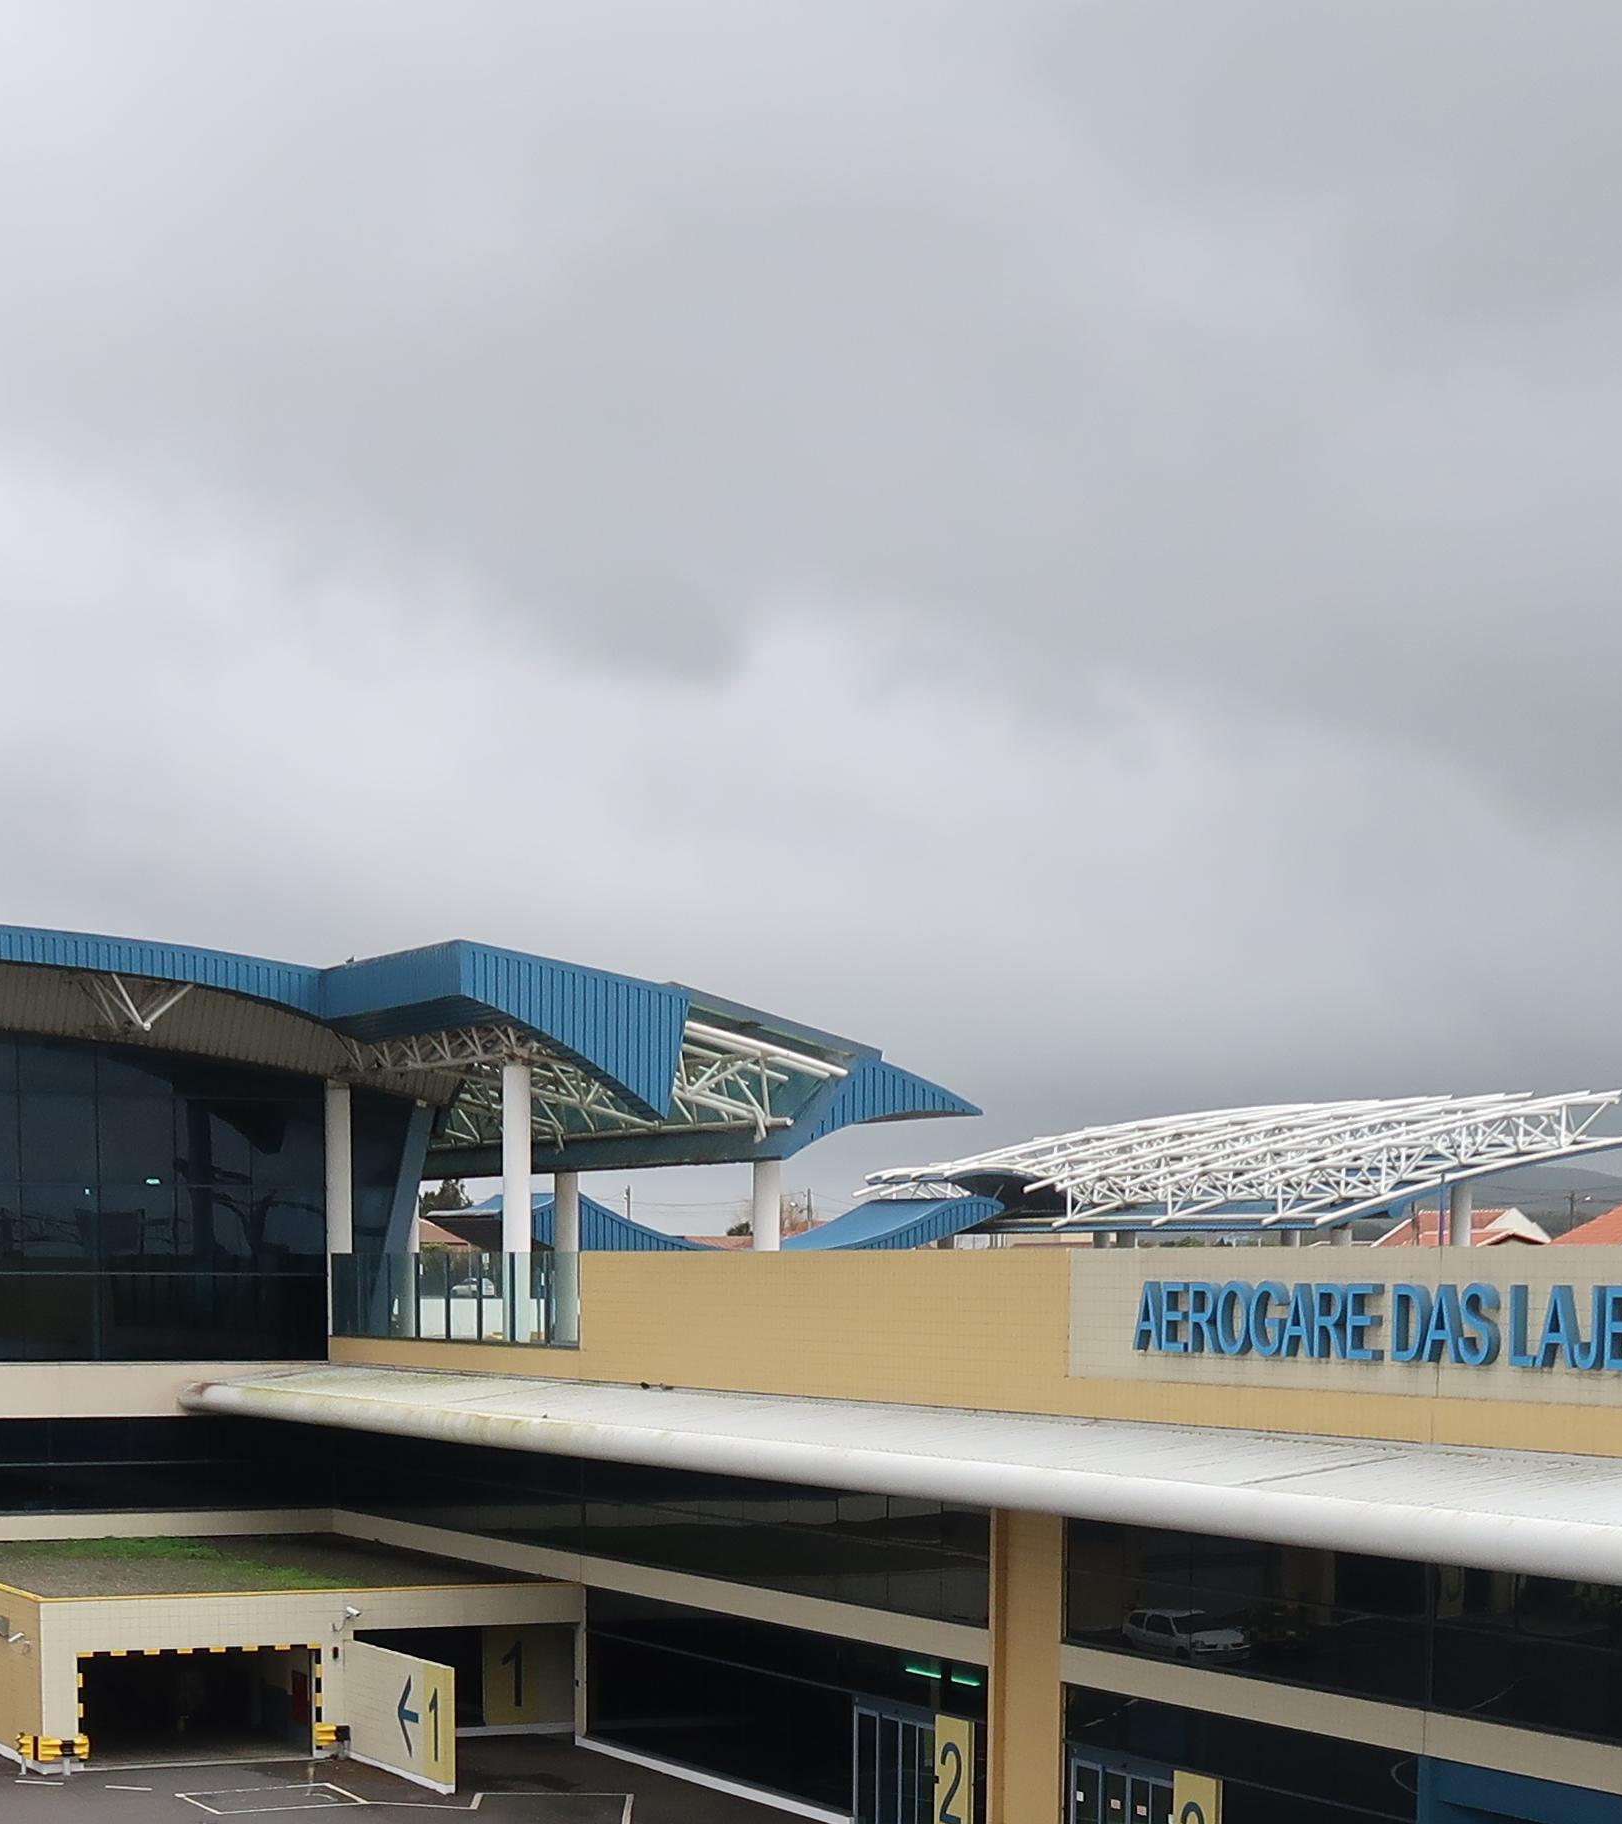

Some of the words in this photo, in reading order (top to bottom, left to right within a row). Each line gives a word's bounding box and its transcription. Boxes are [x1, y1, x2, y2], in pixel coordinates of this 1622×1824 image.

[1134, 1280, 1383, 1360] AEROGARE
[1391, 1282, 1500, 1367] DAS
[501, 1640, 522, 1707] 1
[428, 1686, 440, 1763] 1
